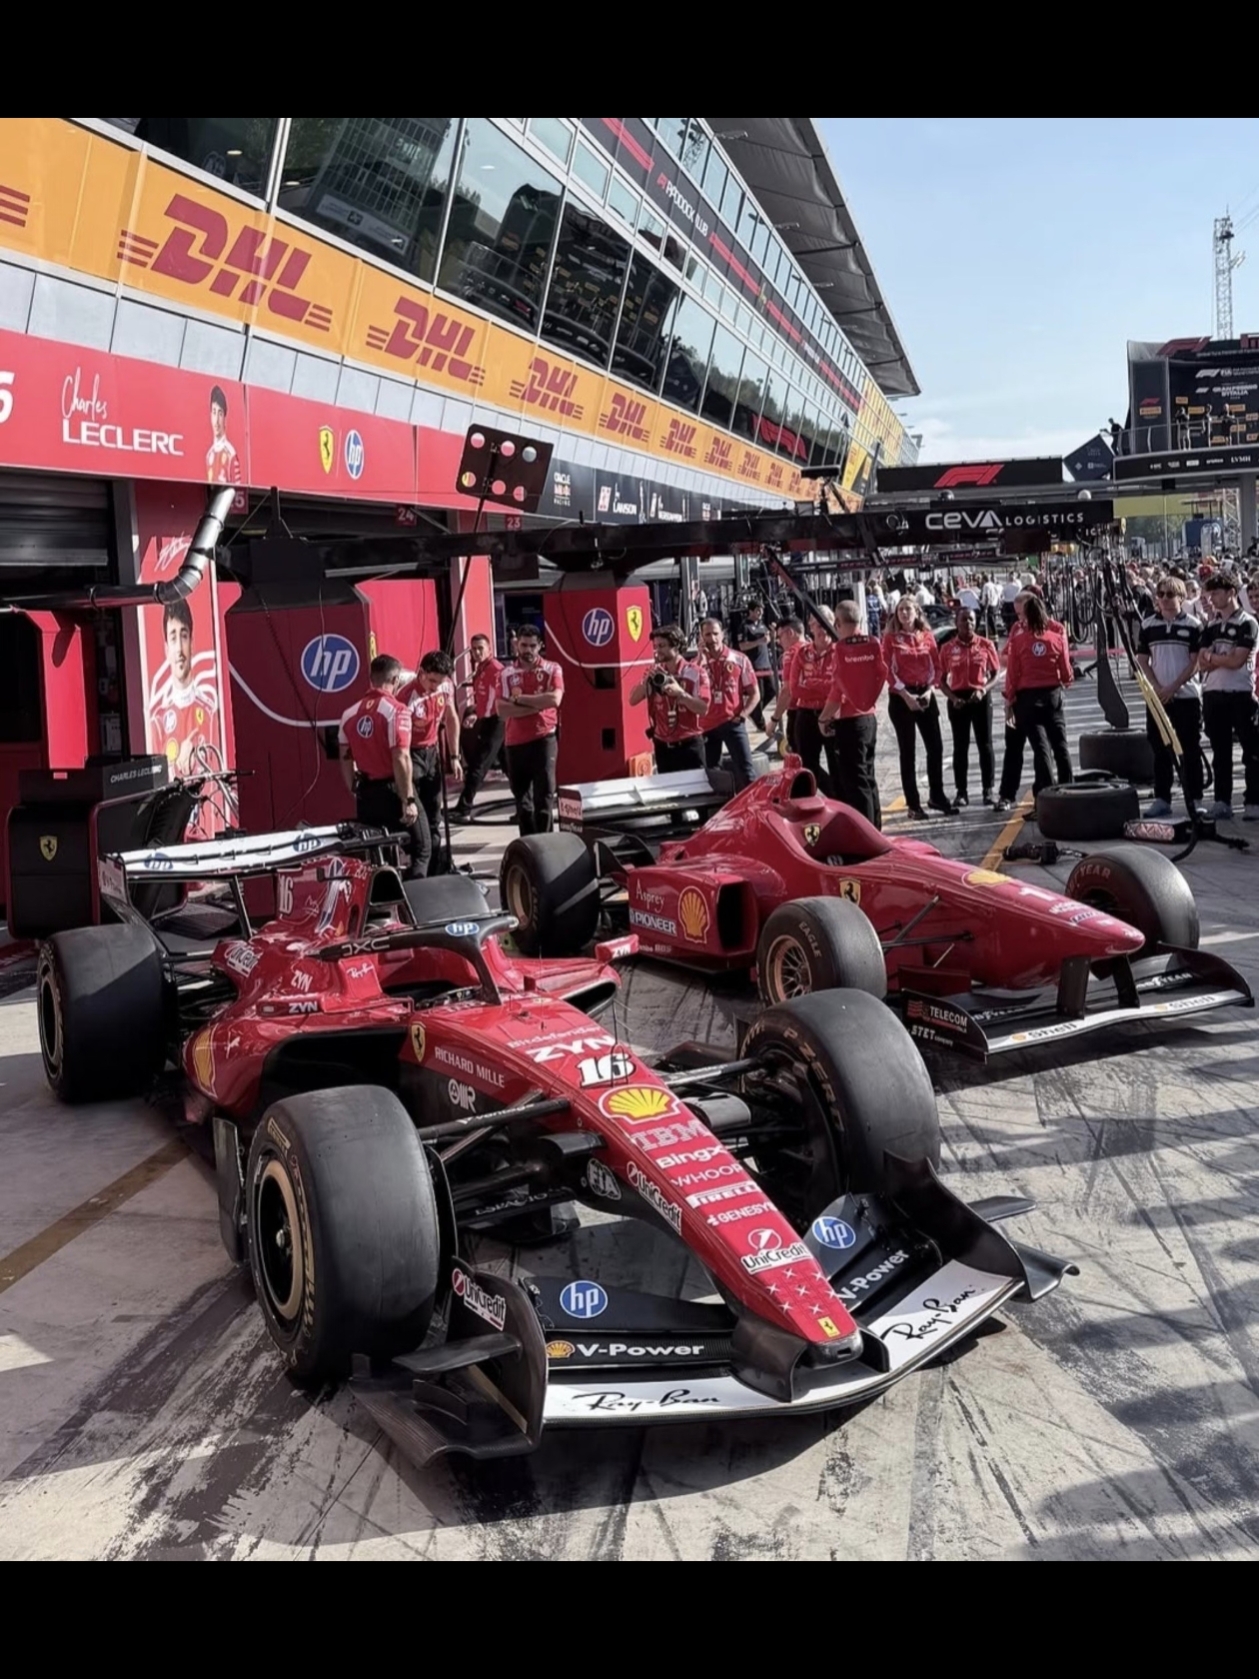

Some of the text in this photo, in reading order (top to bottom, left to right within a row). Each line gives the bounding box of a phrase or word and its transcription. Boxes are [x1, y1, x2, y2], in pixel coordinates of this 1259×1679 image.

[150, 193, 312, 323] DHL
[384, 296, 475, 381] DHL
[61, 366, 109, 420] Charles
[520, 357, 578, 417] DHL
[606, 392, 647, 442] DHL
[62, 418, 185, 457] LECLERC
[664, 418, 697, 458] DHL
[707, 437, 733, 470] DHL
[348, 431, 363, 479] hp
[398, 508, 415, 521] 24
[507, 516, 521, 529] 23
[1005, 512, 1084, 527] LOGISTICS
[587, 608, 611, 646] hp
[309, 635, 352, 691] hp
[844, 654, 875, 663] brembo
[110, 770, 136, 783] CHARLES
[278, 874, 294, 915] 16
[635, 878, 665, 913] Asprey
[450, 920, 475, 935] hp
[634, 911, 677, 935] PIONEER
[799, 921, 822, 958] EAGLE
[341, 936, 391, 957] DXC
[291, 969, 314, 993] ZYN
[289, 1001, 318, 1015] ZYN
[929, 1005, 968, 1028] TELECOM
[1169, 995, 1216, 1010] Shell
[507, 1025, 602, 1049] Bitdefender
[911, 1024, 936, 1041] STET
[1028, 1022, 1078, 1039] Shell
[526, 1035, 617, 1064] ZYN
[434, 1046, 505, 1088] RICHARD MILLE
[576, 1052, 636, 1088] 16
[631, 1119, 712, 1152] IBM
[672, 1162, 742, 1187] WHOOP
[638, 1173, 683, 1229] UniCredit
[818, 1217, 850, 1249] hp
[742, 1243, 810, 1269] UniCredit
[840, 1249, 910, 1301] V-Power
[464, 1275, 506, 1322] UniCredit
[567, 1281, 600, 1318] hp
[880, 1284, 976, 1341] Ray-Ban
[577, 1343, 705, 1357] V-Power
[572, 1389, 721, 1412] Ray-Ban
